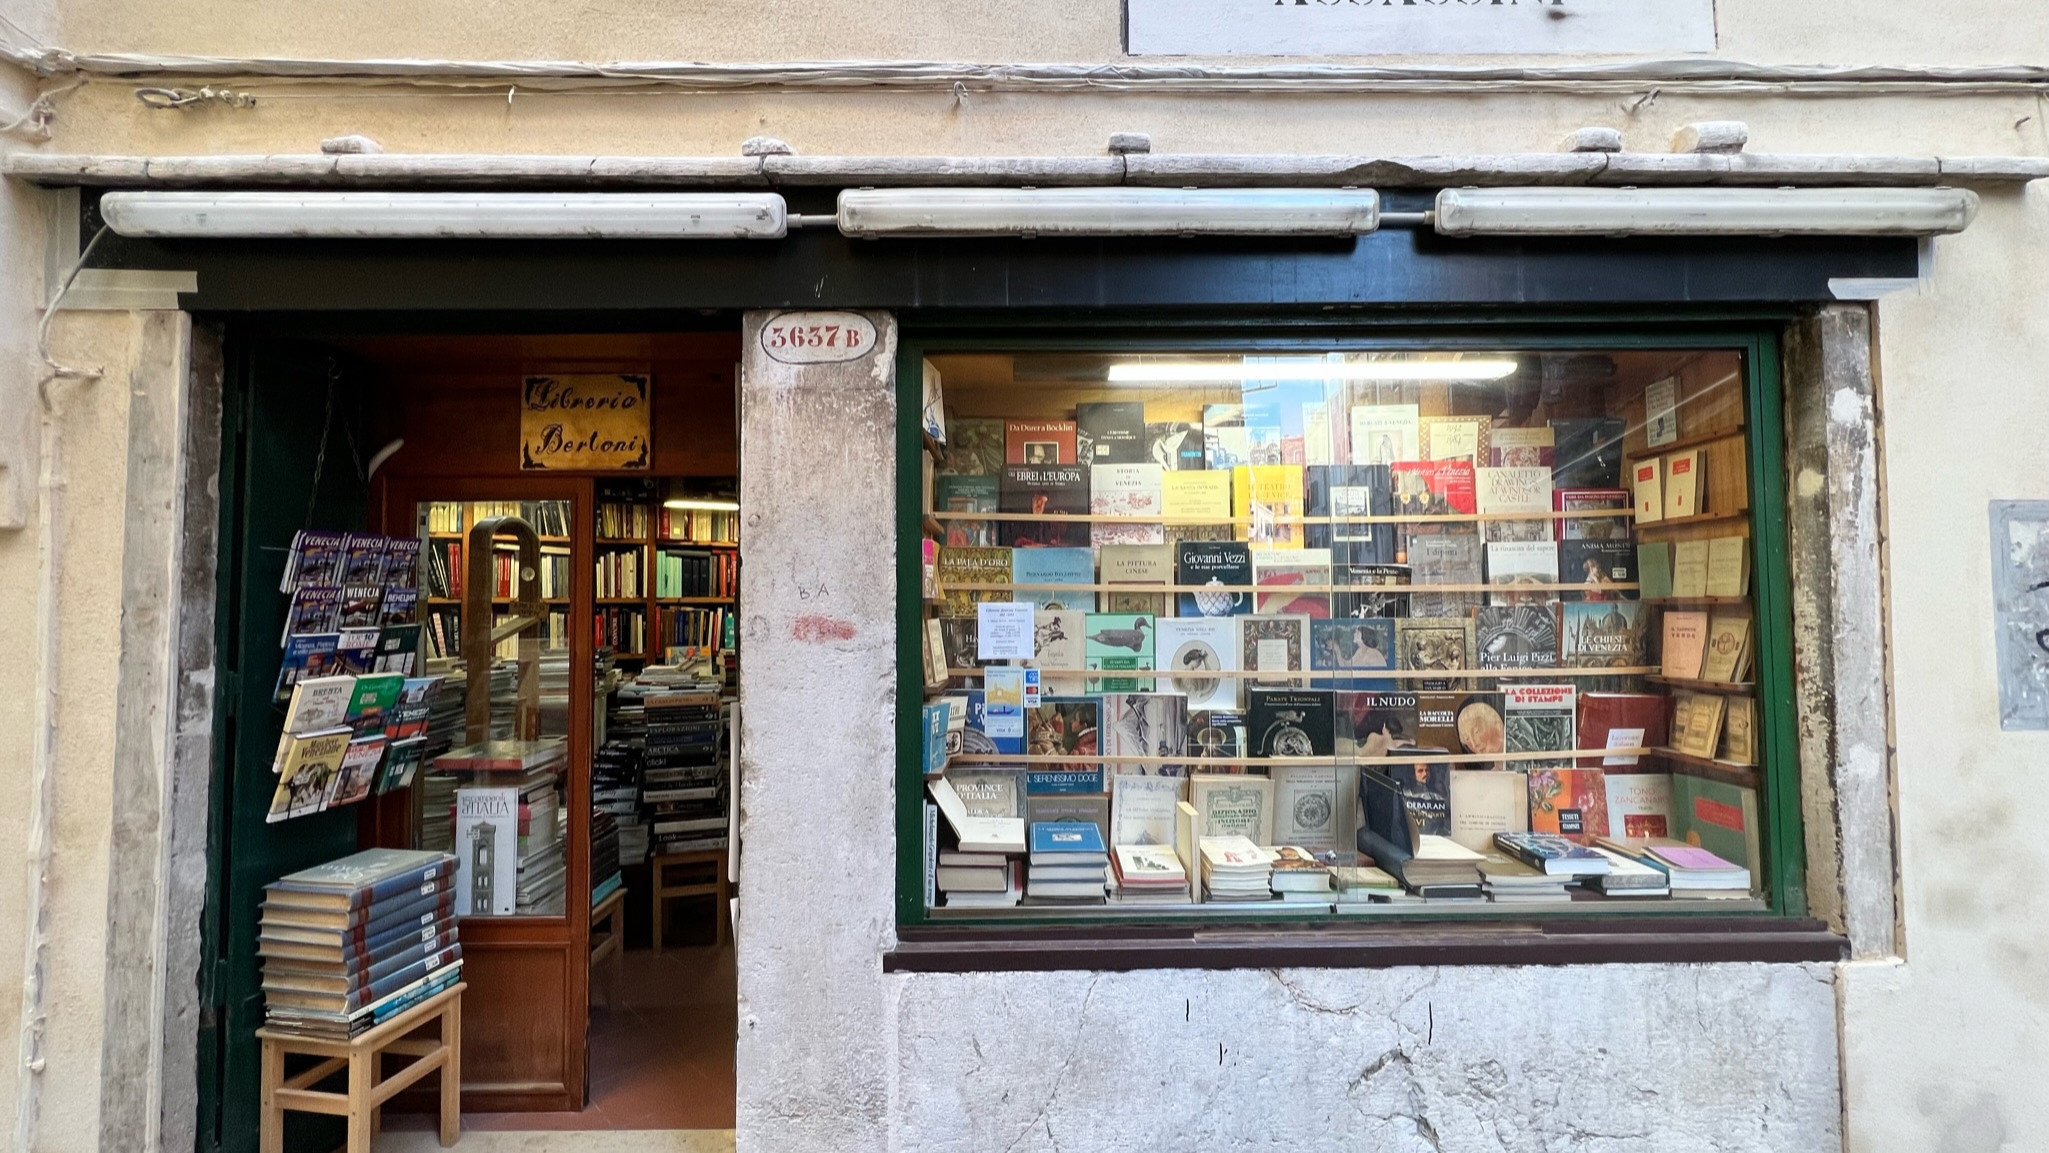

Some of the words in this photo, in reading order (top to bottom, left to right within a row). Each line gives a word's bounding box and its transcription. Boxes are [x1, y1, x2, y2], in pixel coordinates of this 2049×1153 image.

[771, 325, 840, 348] 3637
[845, 328, 861, 348] B
[530, 379, 638, 410] Libreria
[535, 423, 639, 456] Bertoni
[1016, 471, 1039, 481] EBREI
[1043, 471, 1080, 482] L'EUROPA
[1487, 470, 1541, 479] CANALETTO
[305, 536, 340, 546] VENECIA
[351, 538, 383, 549] VENECIA
[389, 540, 419, 550] VENECIA
[1183, 551, 1222, 563] Giovanni
[1224, 552, 1246, 563] Vezzi
[957, 558, 978, 567] PALA
[980, 558, 1008, 566] D'ORO
[301, 588, 336, 600] VENECIA
[347, 587, 379, 597] WENECJA
[818, 583, 829, 597] A
[1593, 635, 1624, 644] CHIESE
[1590, 643, 1628, 652] VENEZIA
[1480, 652, 1500, 662] Pier
[1503, 653, 1529, 664] Luigi
[1367, 697, 1378, 706] IL
[1379, 697, 1415, 707] NUDO
[1078, 774, 1098, 782] DOGE
[956, 784, 1003, 792] PROVINCE
